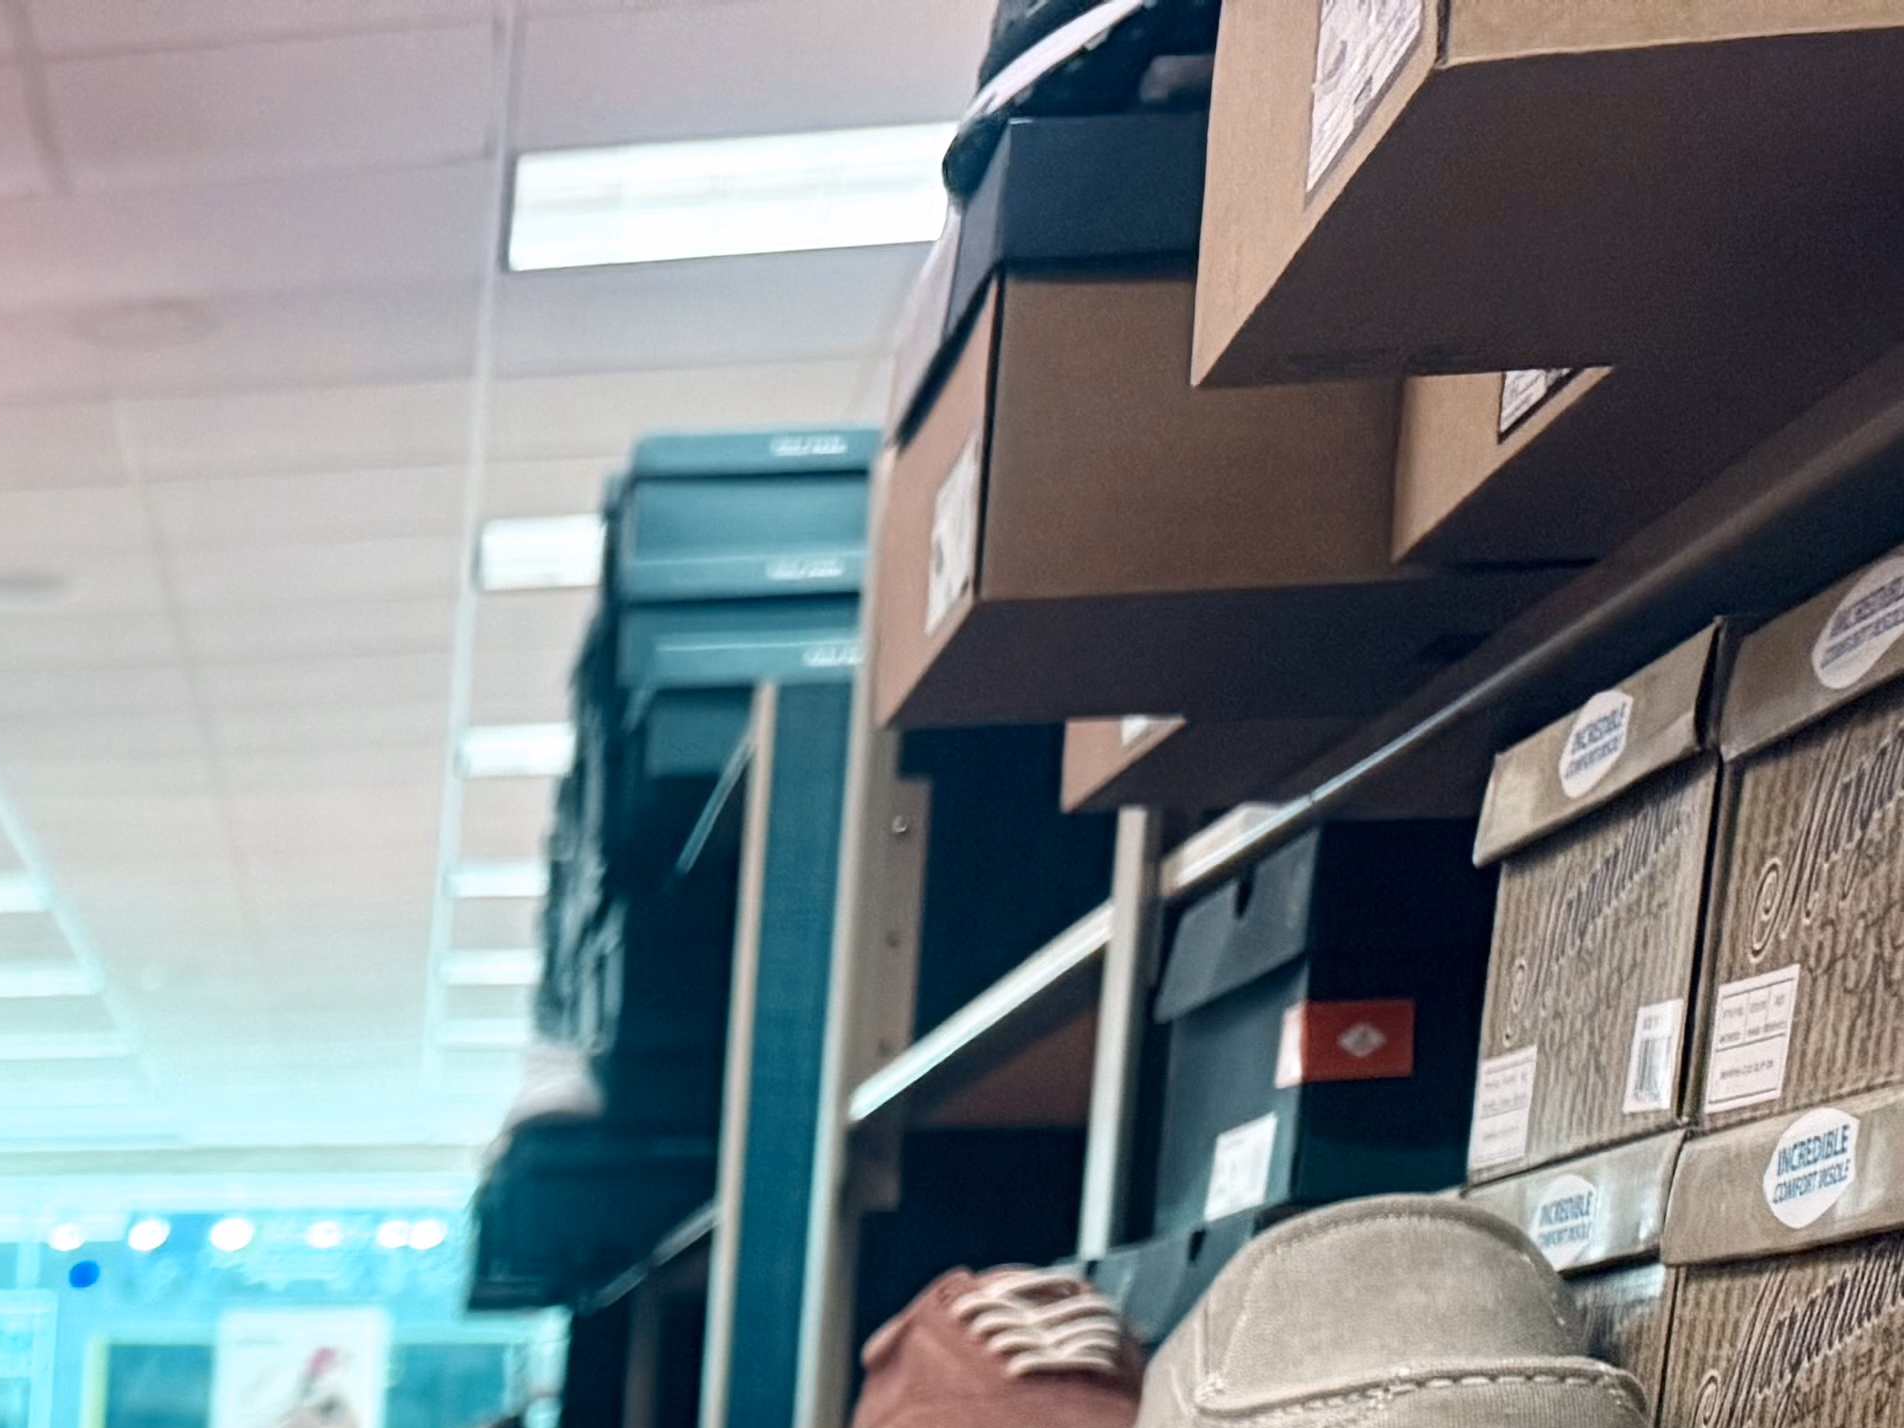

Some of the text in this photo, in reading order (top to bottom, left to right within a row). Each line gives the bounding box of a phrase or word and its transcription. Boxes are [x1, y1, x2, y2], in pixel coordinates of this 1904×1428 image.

[1777, 1125, 1851, 1177] INCREDIBLE
[1772, 1158, 1852, 1205] COMFORT INSOLE
